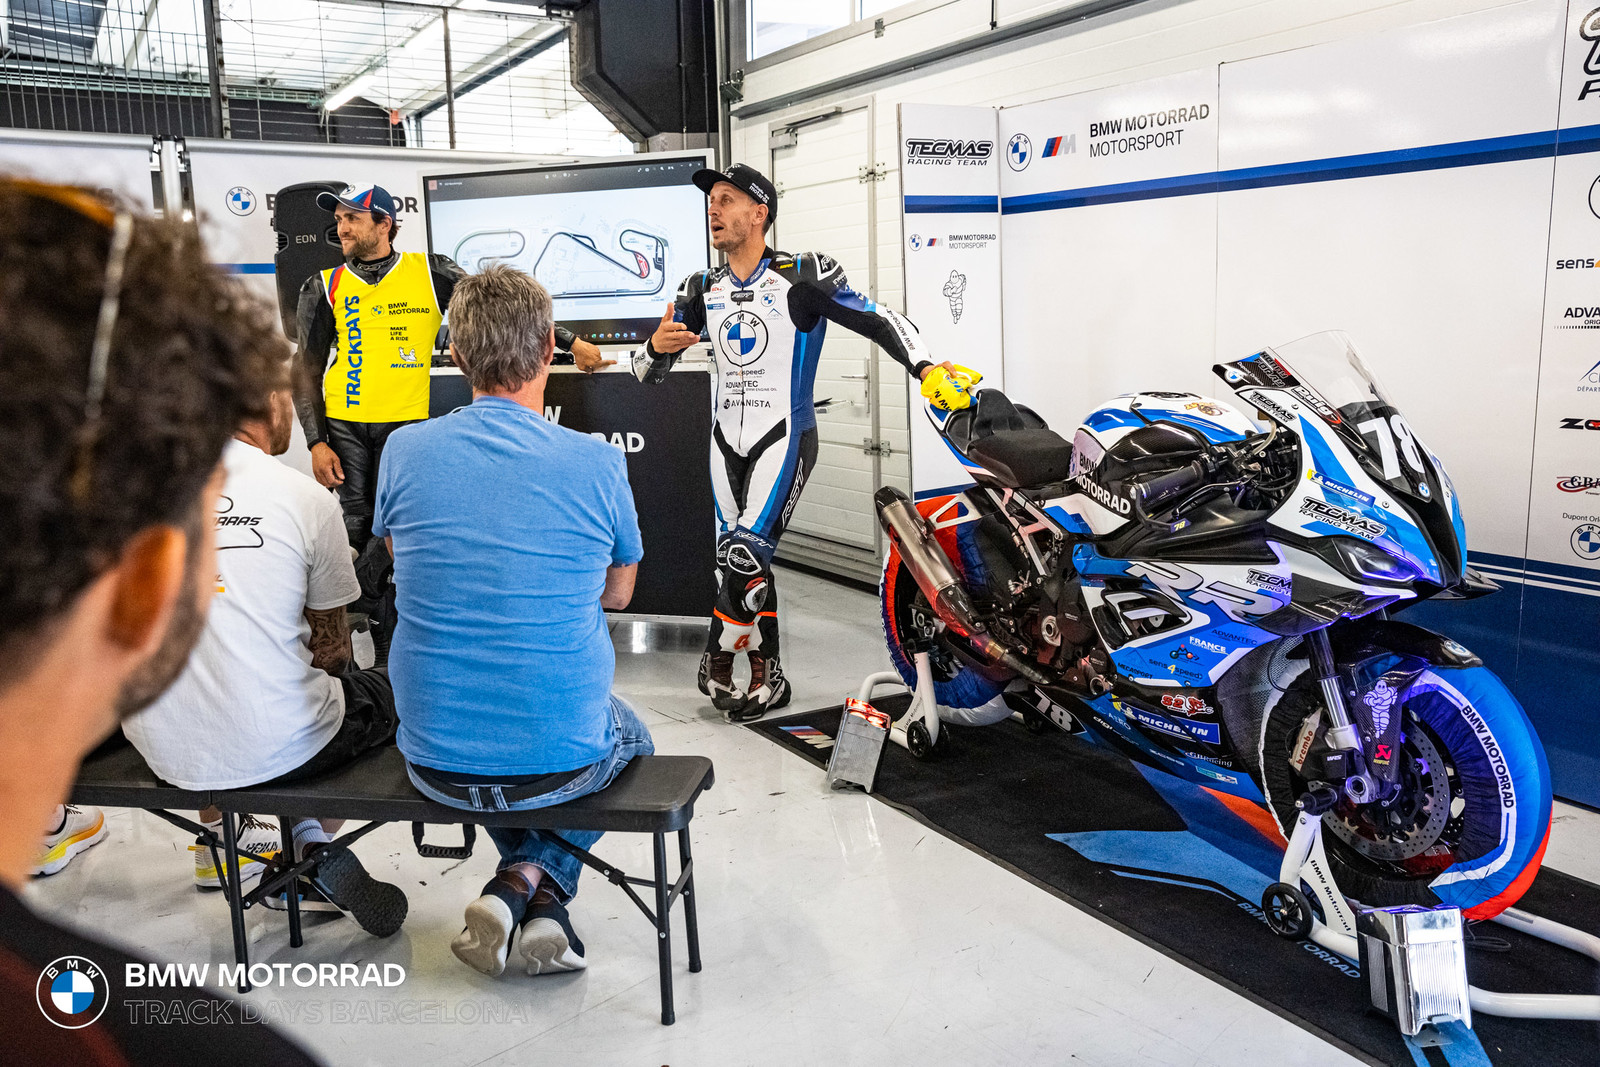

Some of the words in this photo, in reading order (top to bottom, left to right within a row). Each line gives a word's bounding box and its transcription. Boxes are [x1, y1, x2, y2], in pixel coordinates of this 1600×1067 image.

[1089, 118, 1123, 138] BMW
[1125, 104, 1210, 132] MOTORRAD
[907, 140, 992, 159] TECMAS
[1089, 129, 1184, 159] MOTORSPORT
[907, 158, 952, 166] RACING
[957, 159, 988, 167] TEAM
[295, 234, 317, 244] EON
[948, 234, 963, 242] BMW
[963, 234, 996, 242] MOTORRAD
[948, 242, 987, 250] MOTORSPORT
[388, 302, 408, 310] BMW
[389, 308, 430, 316] MOTORRAD
[724, 313, 761, 330] BMW
[345, 295, 363, 408] TRACKDAYS
[731, 399, 771, 408] AVANISTA
[1252, 390, 1296, 421] TECMAS
[1291, 385, 1334, 416] Puig
[1357, 414, 1425, 481] 78
[782, 457, 805, 528] RST
[1075, 475, 1131, 515] MOTORRAD
[1324, 480, 1370, 503] MICHELIN
[1173, 520, 1186, 531] 78
[1299, 508, 1342, 528] RACING
[1345, 525, 1375, 541] TEAM
[1302, 497, 1386, 536] TECMAS
[1562, 512, 1588, 522] Dupont
[1246, 579, 1282, 593] RACING
[1189, 636, 1227, 653] FRANCE
[1211, 629, 1258, 646] ADVANTEC
[1034, 688, 1072, 732] 78
[1296, 730, 1314, 765] brembo
[1462, 704, 1488, 734] BMW
[1482, 735, 1514, 808] MOTORRAD
[1310, 860, 1327, 884] BMW
[1324, 886, 1352, 932] Motorrad
